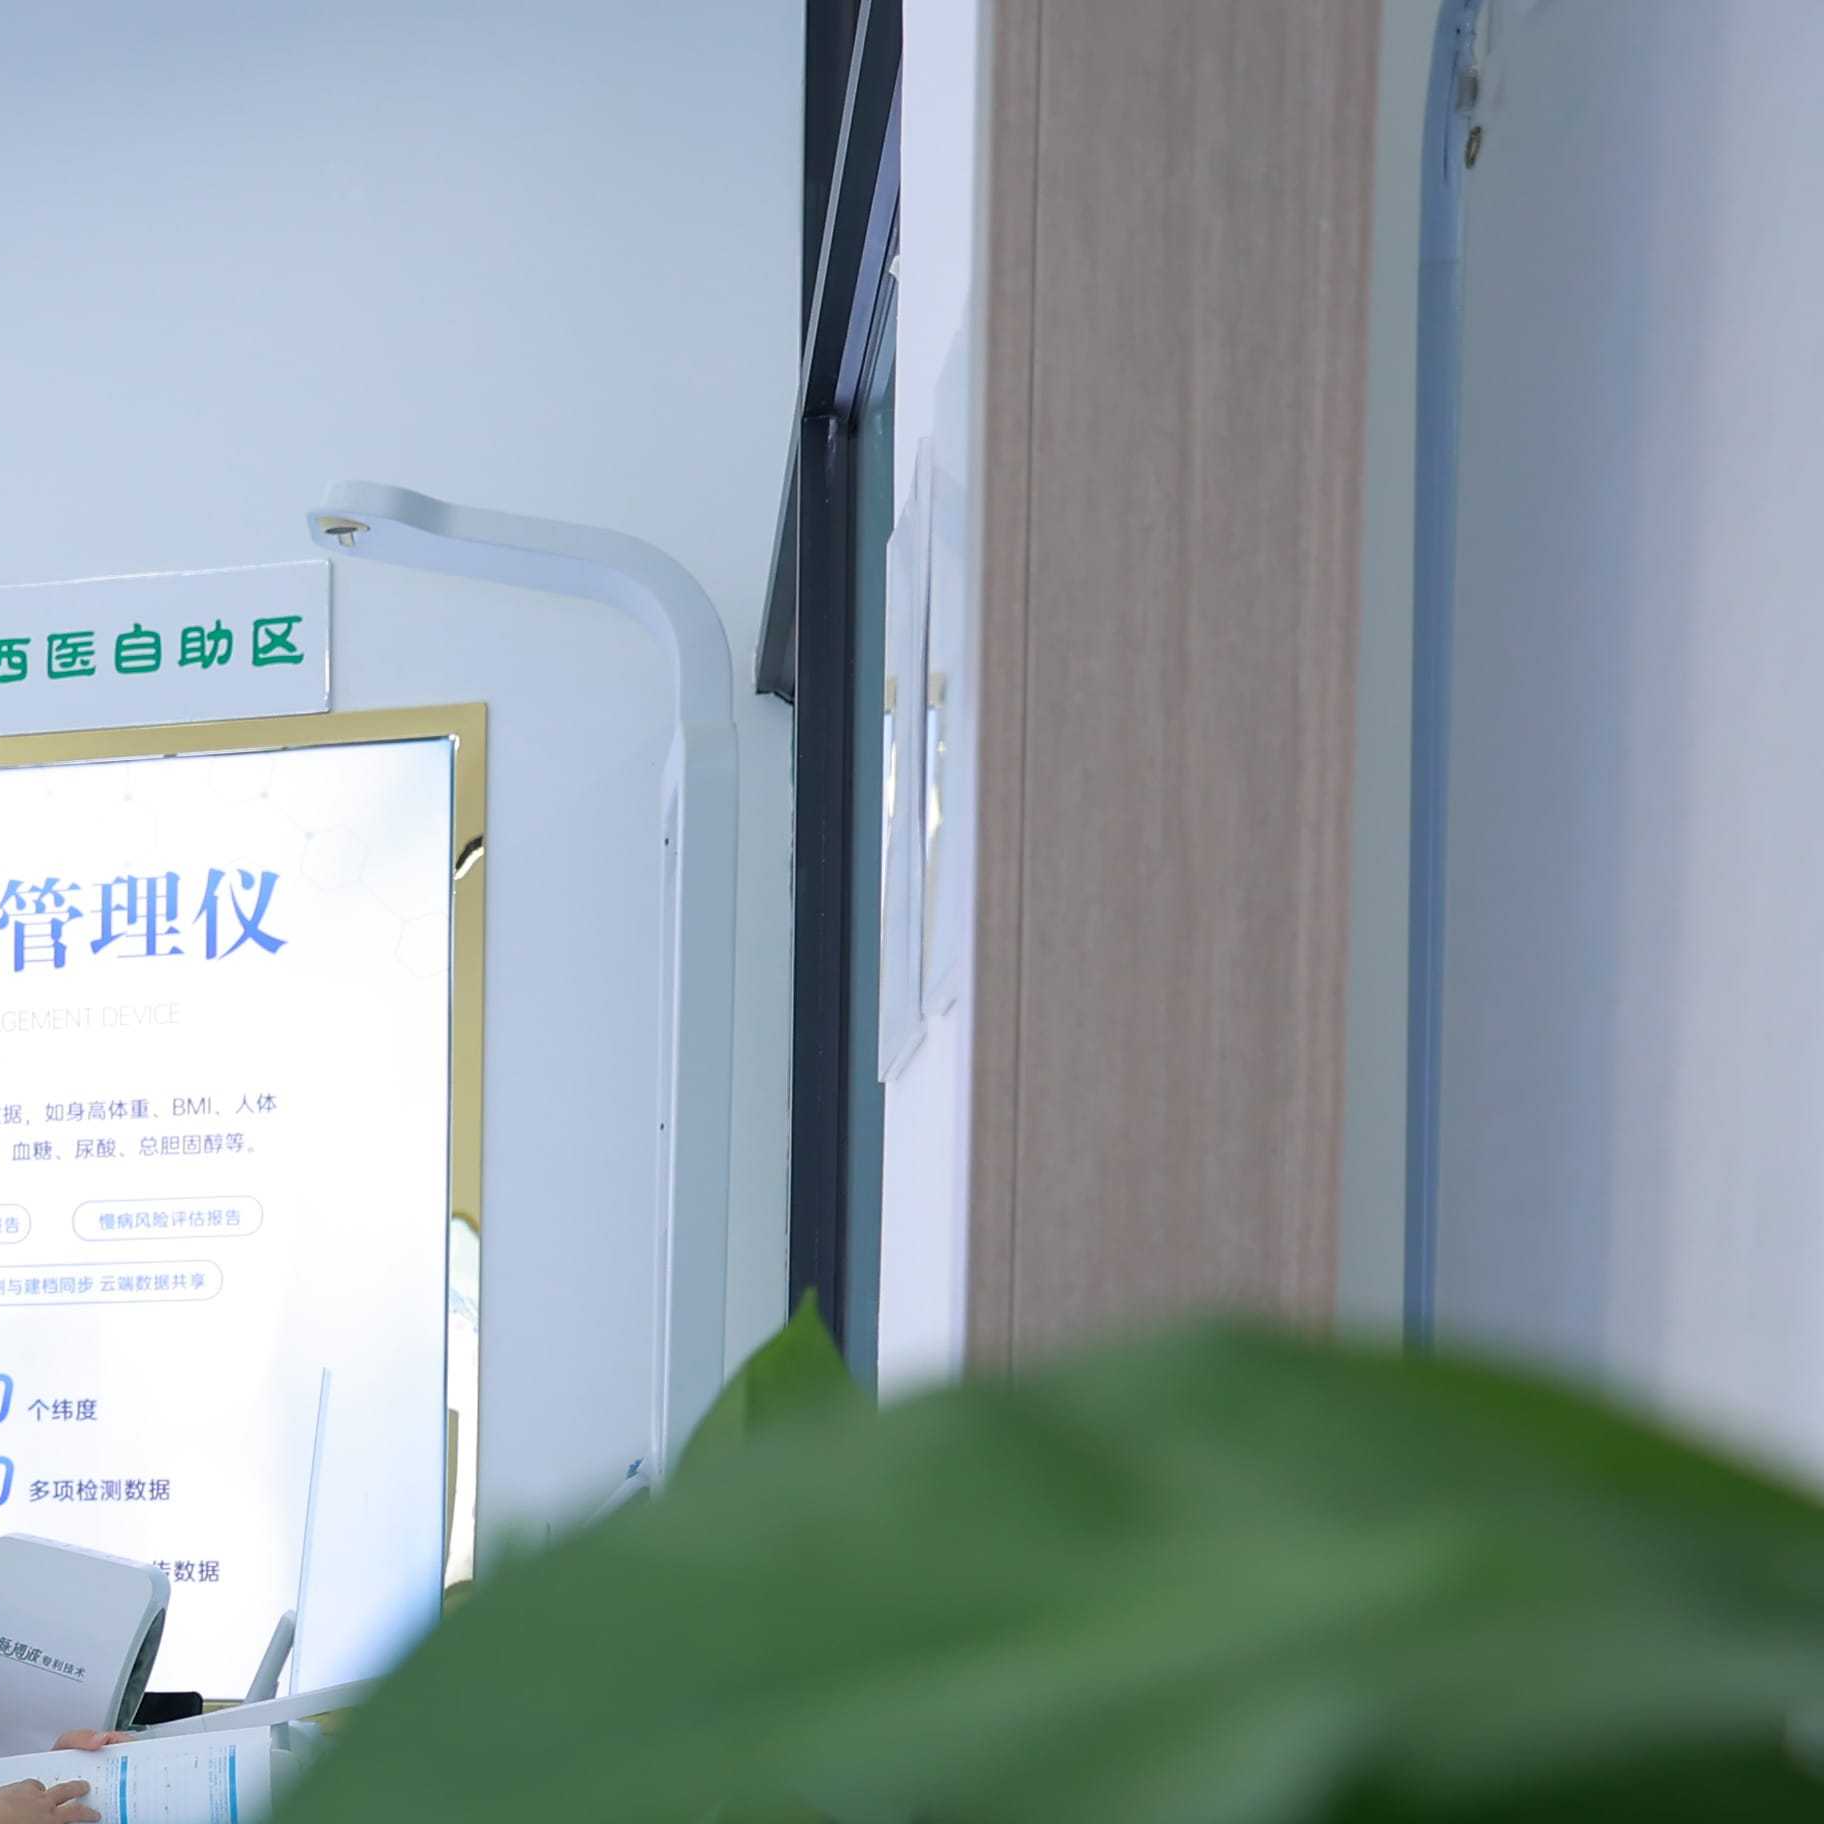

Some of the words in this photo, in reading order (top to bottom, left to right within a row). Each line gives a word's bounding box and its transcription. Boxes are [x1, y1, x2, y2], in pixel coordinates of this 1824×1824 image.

[102, 1001, 182, 1027] DEVICE
[98, 1209, 242, 1231] 慢病风险评估报告
[100, 1272, 206, 1293] 云端数据共享
[27, 1398, 98, 1423] 个纬度
[29, 1478, 171, 1503] 多项检测数据
